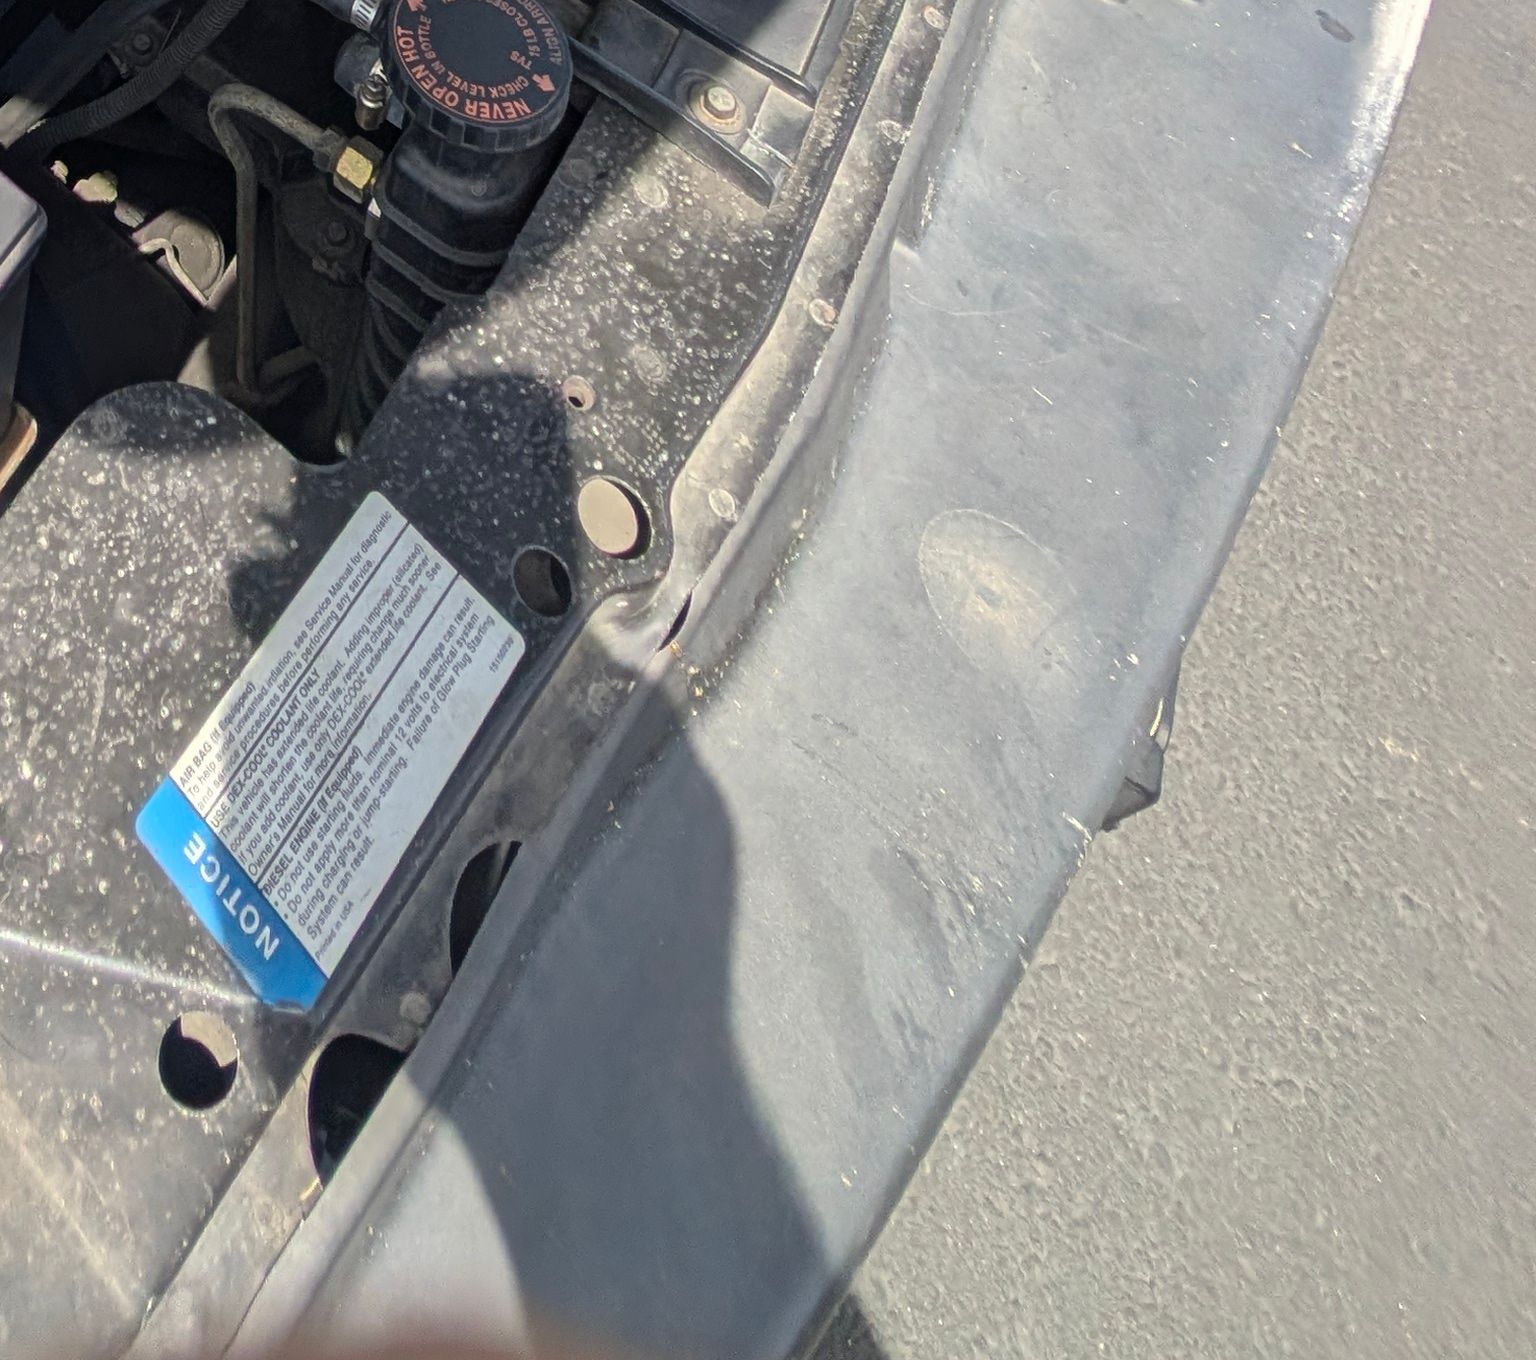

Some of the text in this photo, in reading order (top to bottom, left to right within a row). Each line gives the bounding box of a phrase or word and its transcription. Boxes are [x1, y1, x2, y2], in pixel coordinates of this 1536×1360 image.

[397, 25, 532, 119] NEVER OPEN HOT
[418, 15, 436, 59] BOTTLE
[446, 71, 486, 97] LEVEL
[488, 75, 529, 98] CHECK
[229, 584, 410, 852] coolant will shorten the coolant requiring change much
[245, 560, 441, 856] you add use only extended See
[265, 668, 321, 747] COOLANT ONLY
[275, 585, 395, 758] extended Adding improper
[248, 748, 335, 876] Owner's Manual for more
[277, 623, 456, 900] Do not use starting Immediate engine damage can
[287, 611, 480, 913] Do not apply more than nominal 12 volts to electrical system
[297, 613, 495, 928] during charging or Failure of Glow Plug Starting
[183, 832, 281, 963] NOTICE
[263, 808, 320, 894] DIESEL ENGINE
[306, 869, 353, 940] System can
